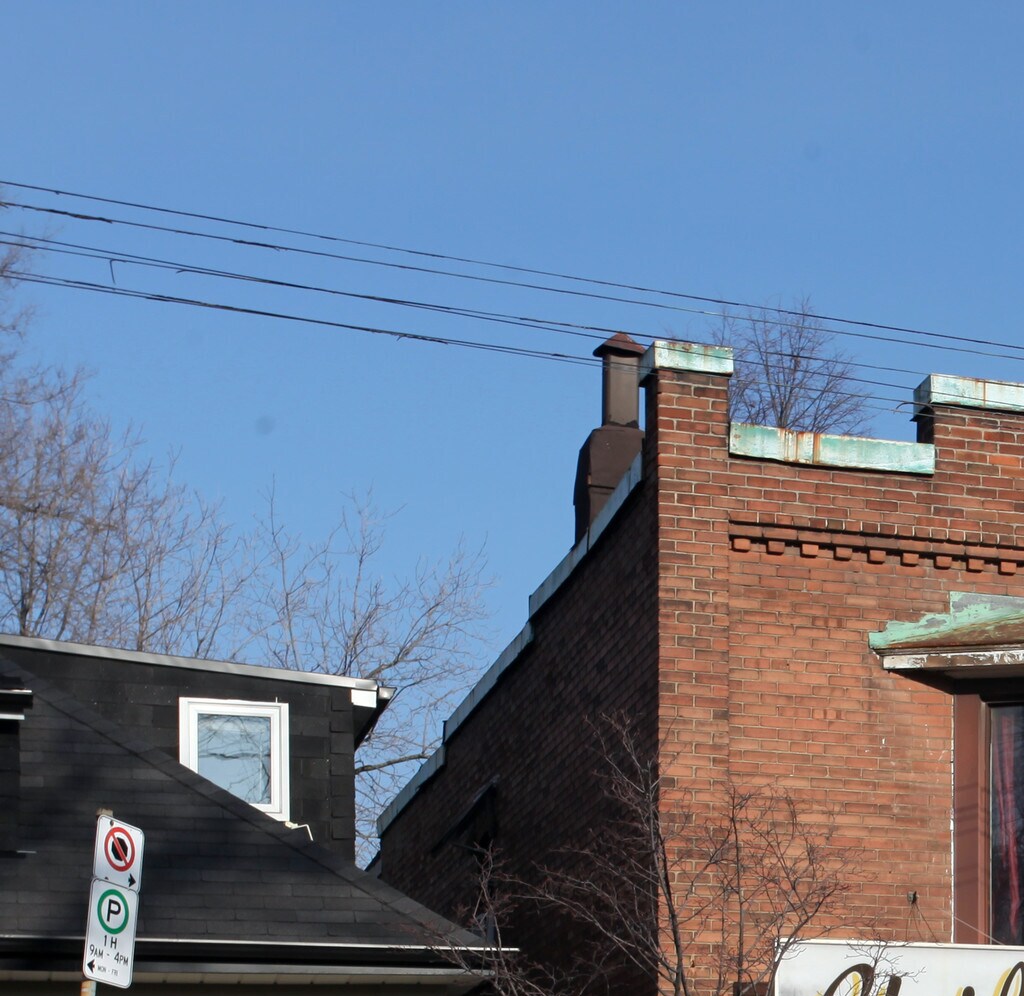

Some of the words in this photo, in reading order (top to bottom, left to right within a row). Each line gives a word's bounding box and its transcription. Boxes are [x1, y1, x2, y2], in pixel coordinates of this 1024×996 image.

[106, 898, 122, 922] P
[89, 943, 104, 960] 9AM
[113, 951, 129, 967] 4PM
[110, 936, 118, 950] H
